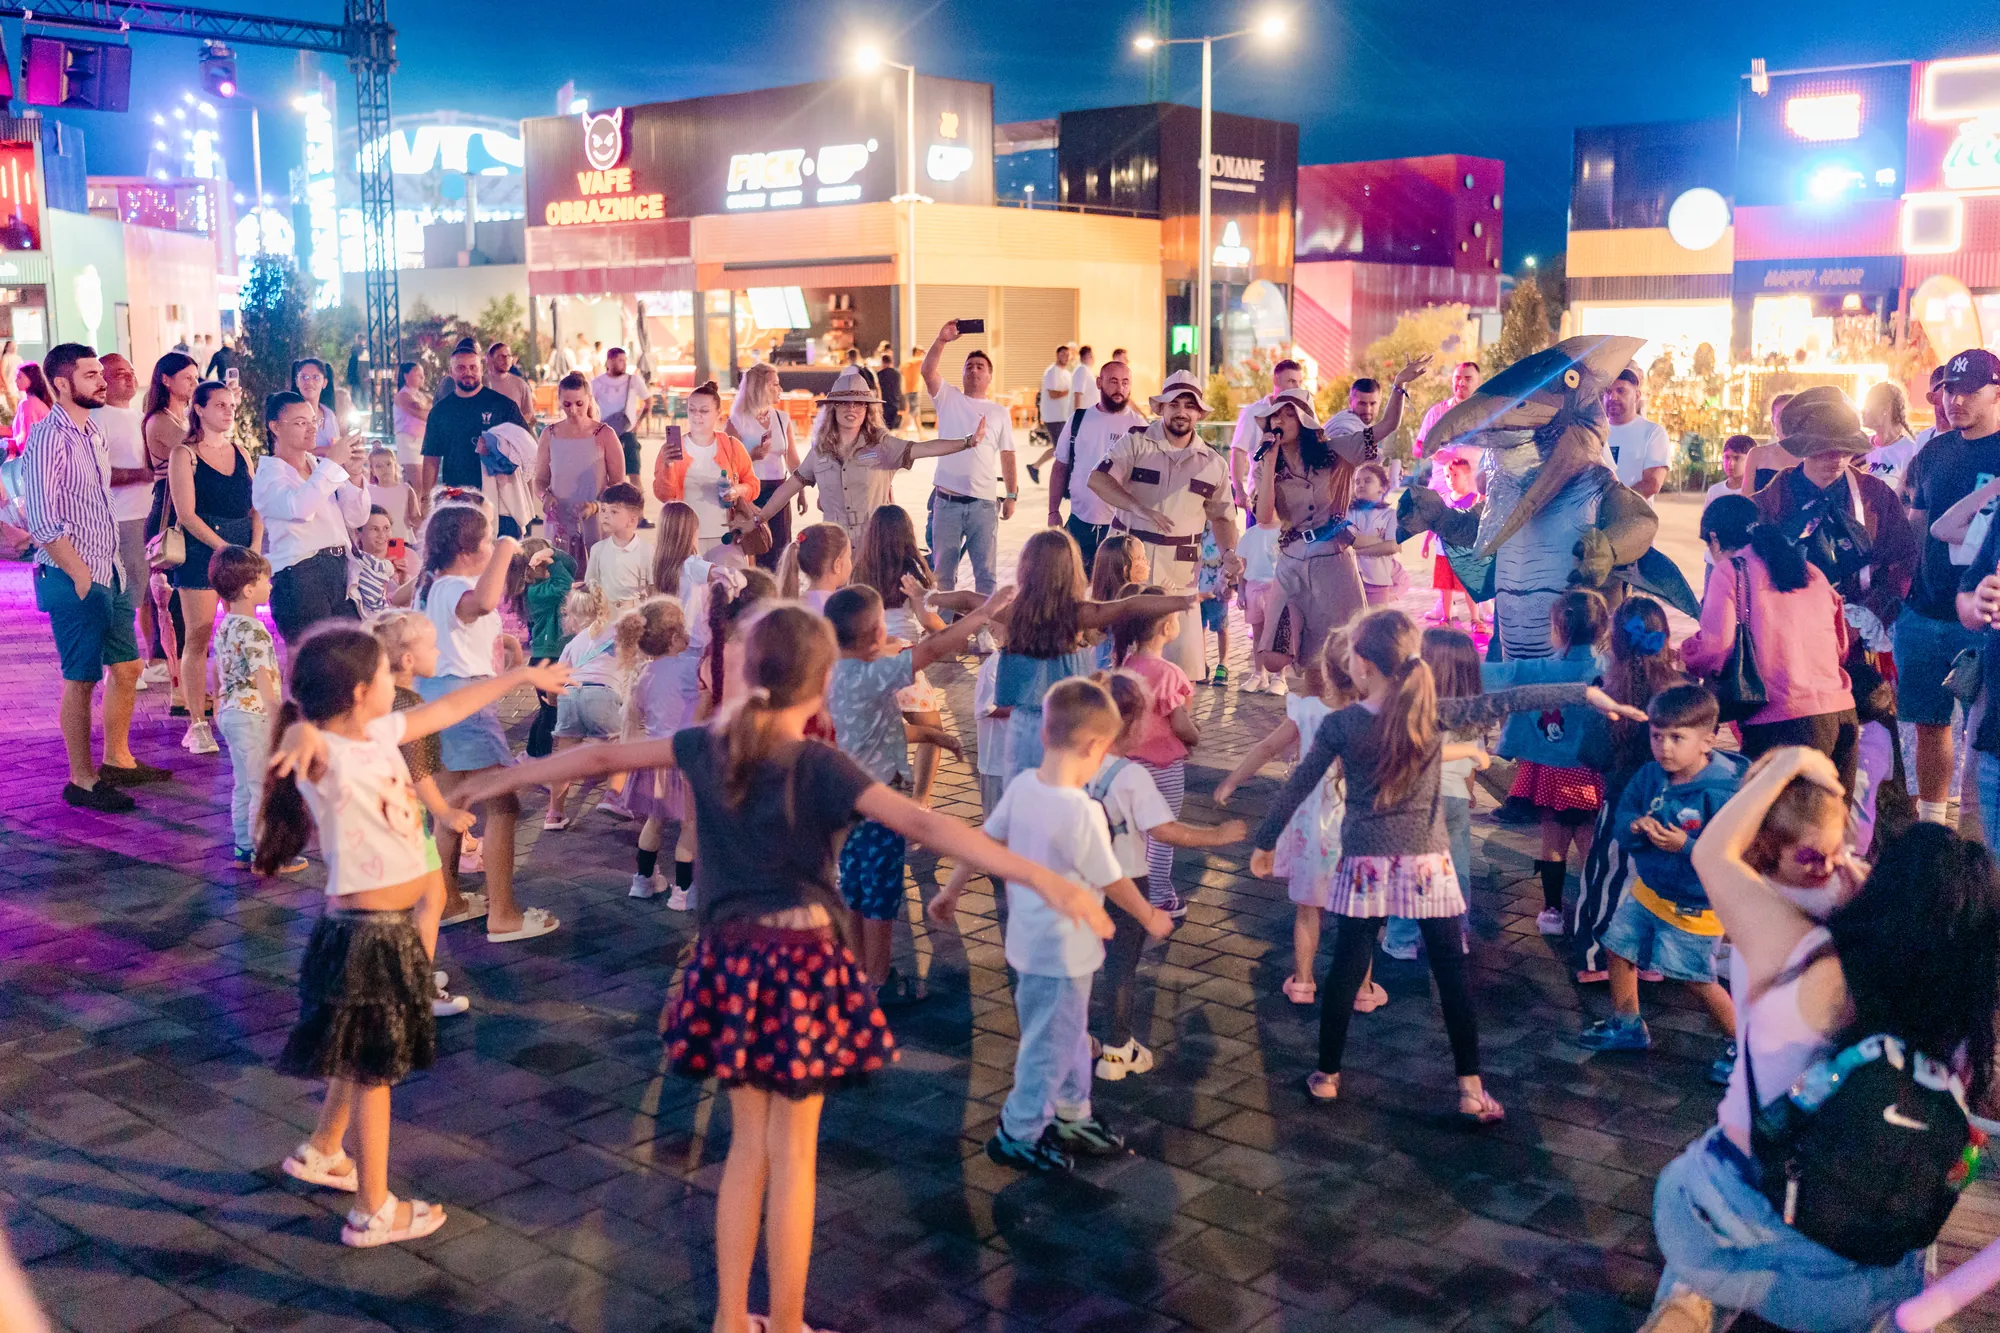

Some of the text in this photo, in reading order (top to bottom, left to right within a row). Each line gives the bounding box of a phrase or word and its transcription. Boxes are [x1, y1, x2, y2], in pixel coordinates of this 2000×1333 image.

[577, 168, 631, 195] VAFE
[546, 194, 664, 226] OBRAZNICE
[1952, 356, 1969, 372] NY
